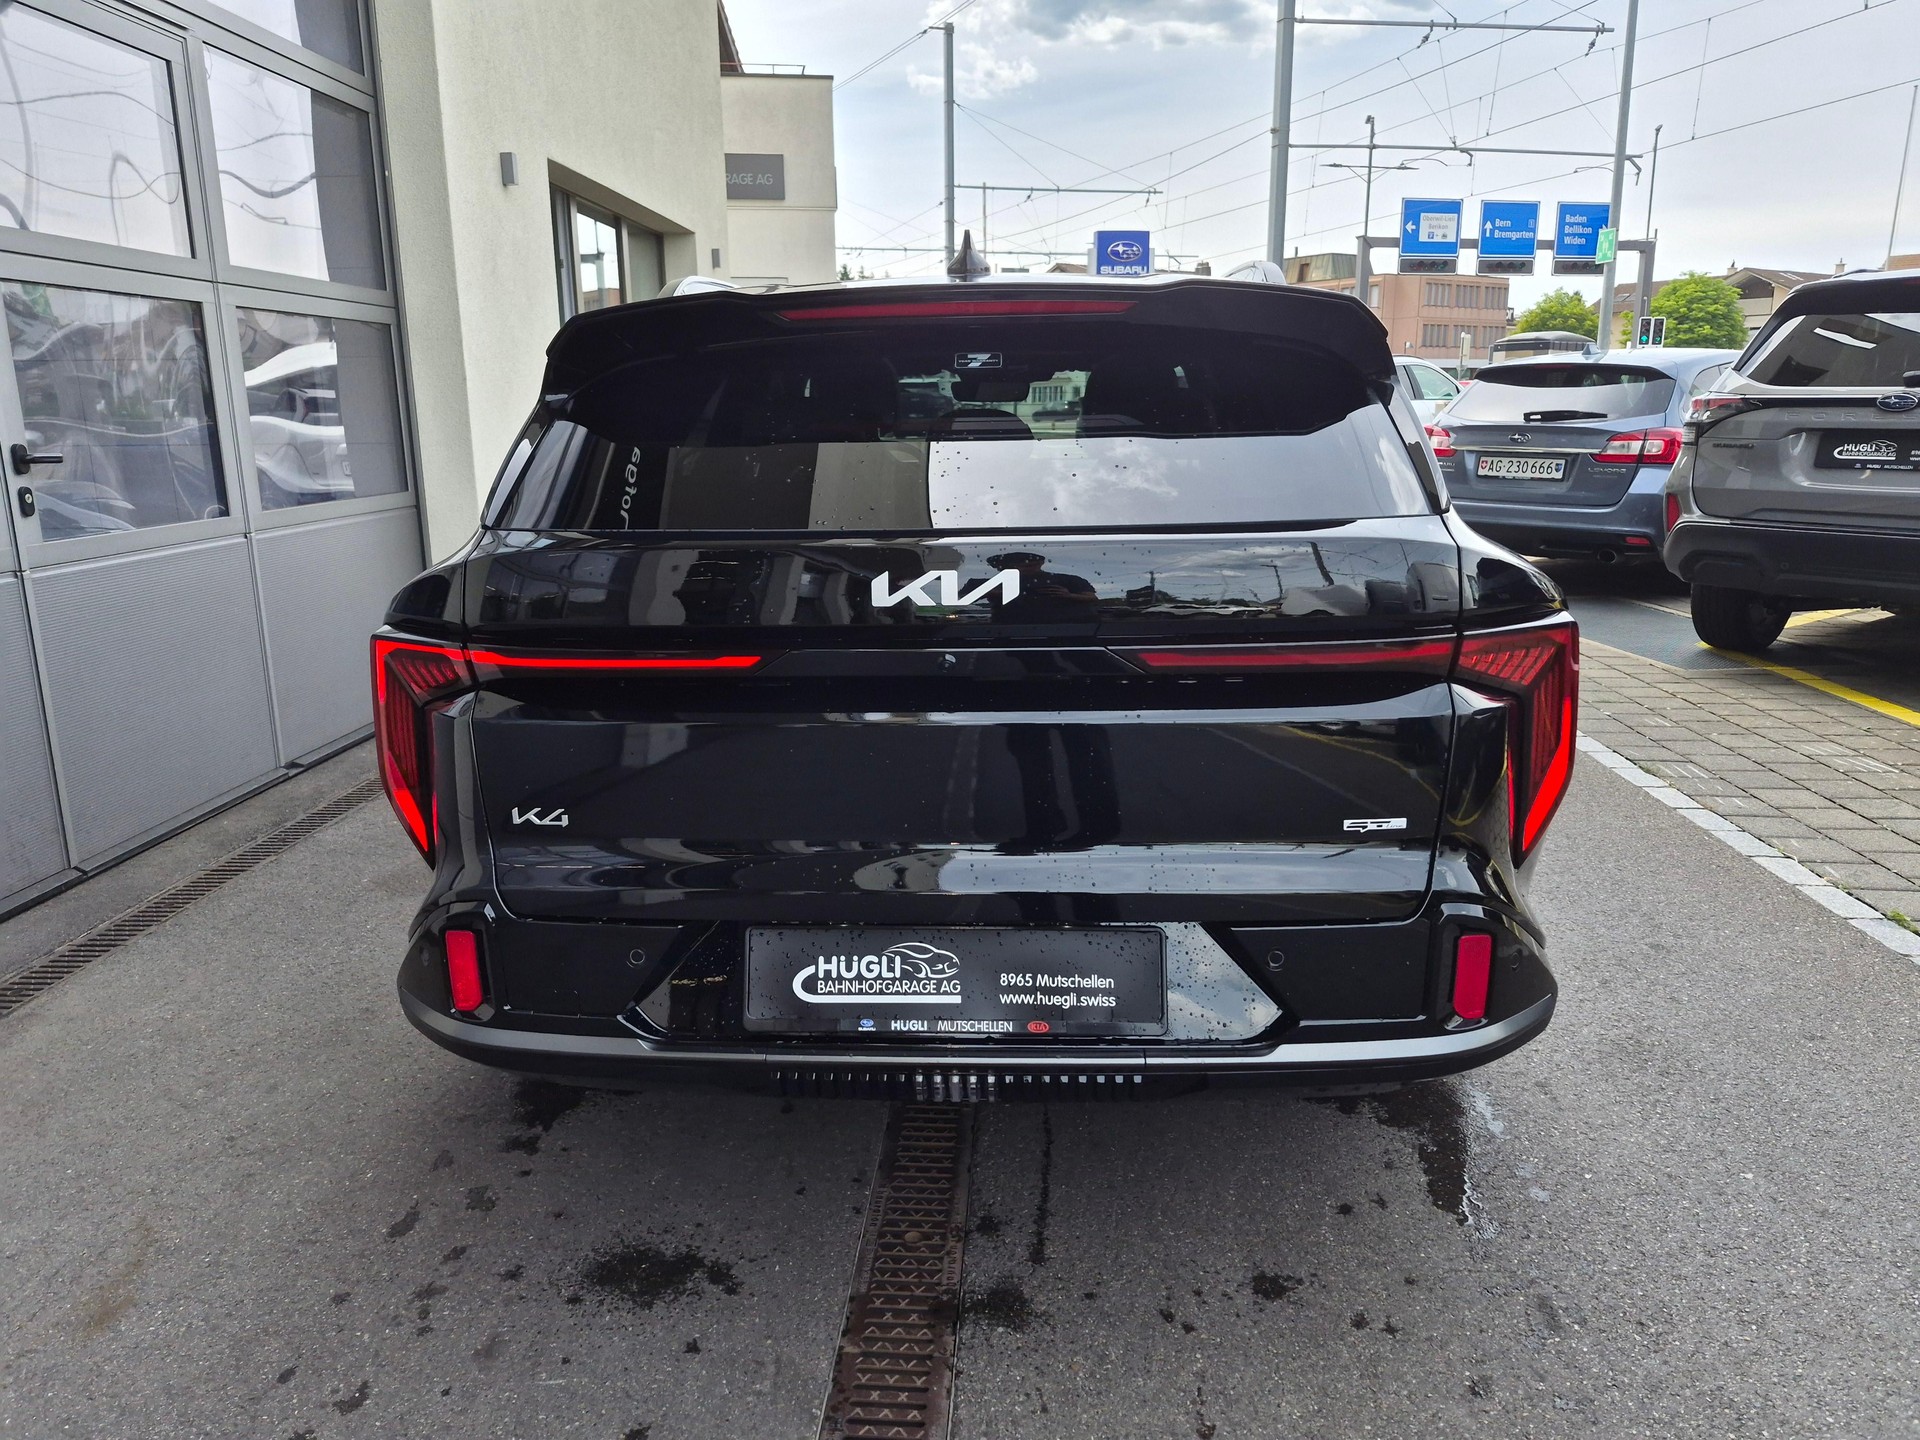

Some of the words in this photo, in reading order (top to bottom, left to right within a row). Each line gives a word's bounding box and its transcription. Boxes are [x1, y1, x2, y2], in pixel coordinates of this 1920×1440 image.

[756, 173, 773, 185] AG
[1495, 218, 1511, 227] Bern
[1565, 214, 1587, 223] Baden
[1494, 230, 1534, 240] Bremgarten
[1564, 225, 1593, 234] Bellikon
[1563, 236, 1586, 245] Widen
[1100, 265, 1147, 274] SUBARU
[871, 569, 1020, 607] KIA
[511, 807, 569, 828] K4
[818, 955, 901, 979] HÜGLI
[817, 980, 937, 994] BAHNHOFGARAGE
[940, 981, 961, 994] AG
[1000, 973, 1033, 987] 8965
[1036, 974, 1115, 989] Mutschellen
[999, 991, 1117, 1009] www.huegli.swiss
[937, 1020, 1013, 1033] MUTSCHELLEN
